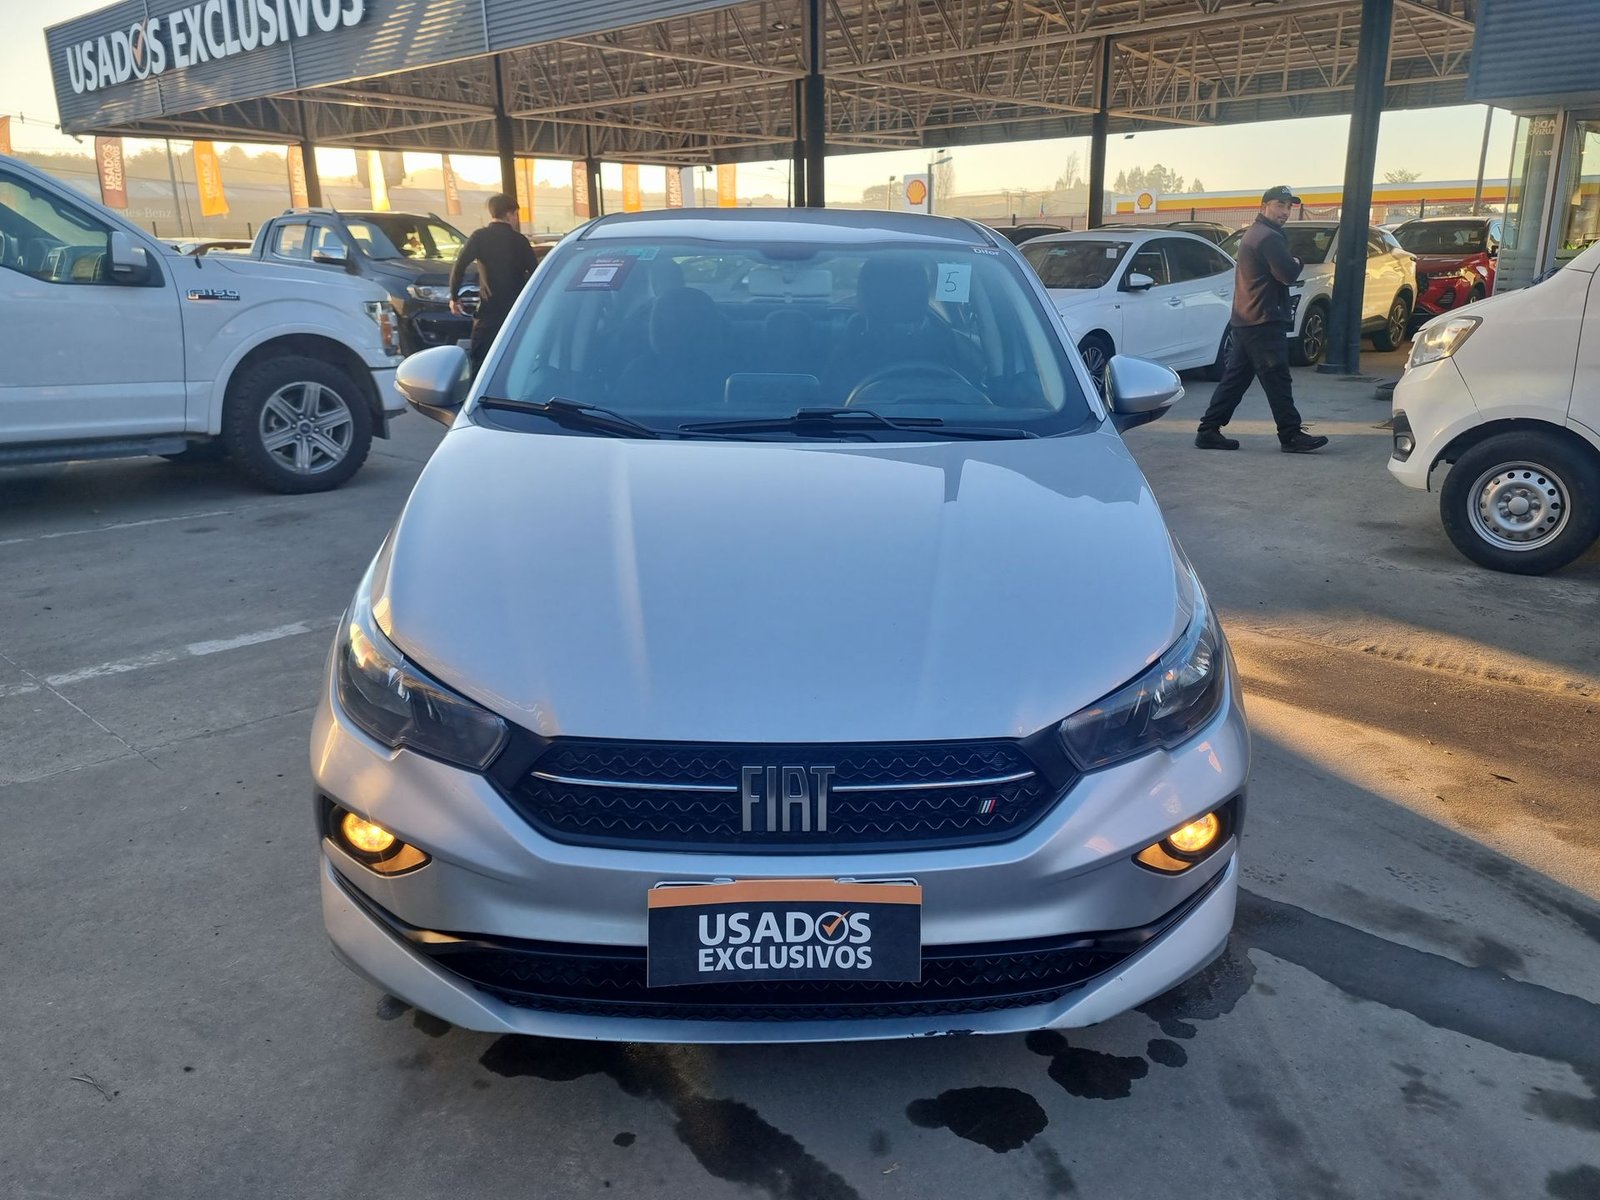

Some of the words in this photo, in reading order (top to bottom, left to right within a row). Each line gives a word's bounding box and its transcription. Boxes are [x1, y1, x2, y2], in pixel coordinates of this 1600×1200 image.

[66, 16, 166, 94] USADOS
[103, 144, 116, 191] USADOS
[945, 271, 960, 293] 5
[742, 766, 836, 832] FIAT
[698, 911, 872, 946] USADOS
[698, 946, 873, 972] EXCLUSIVOS
